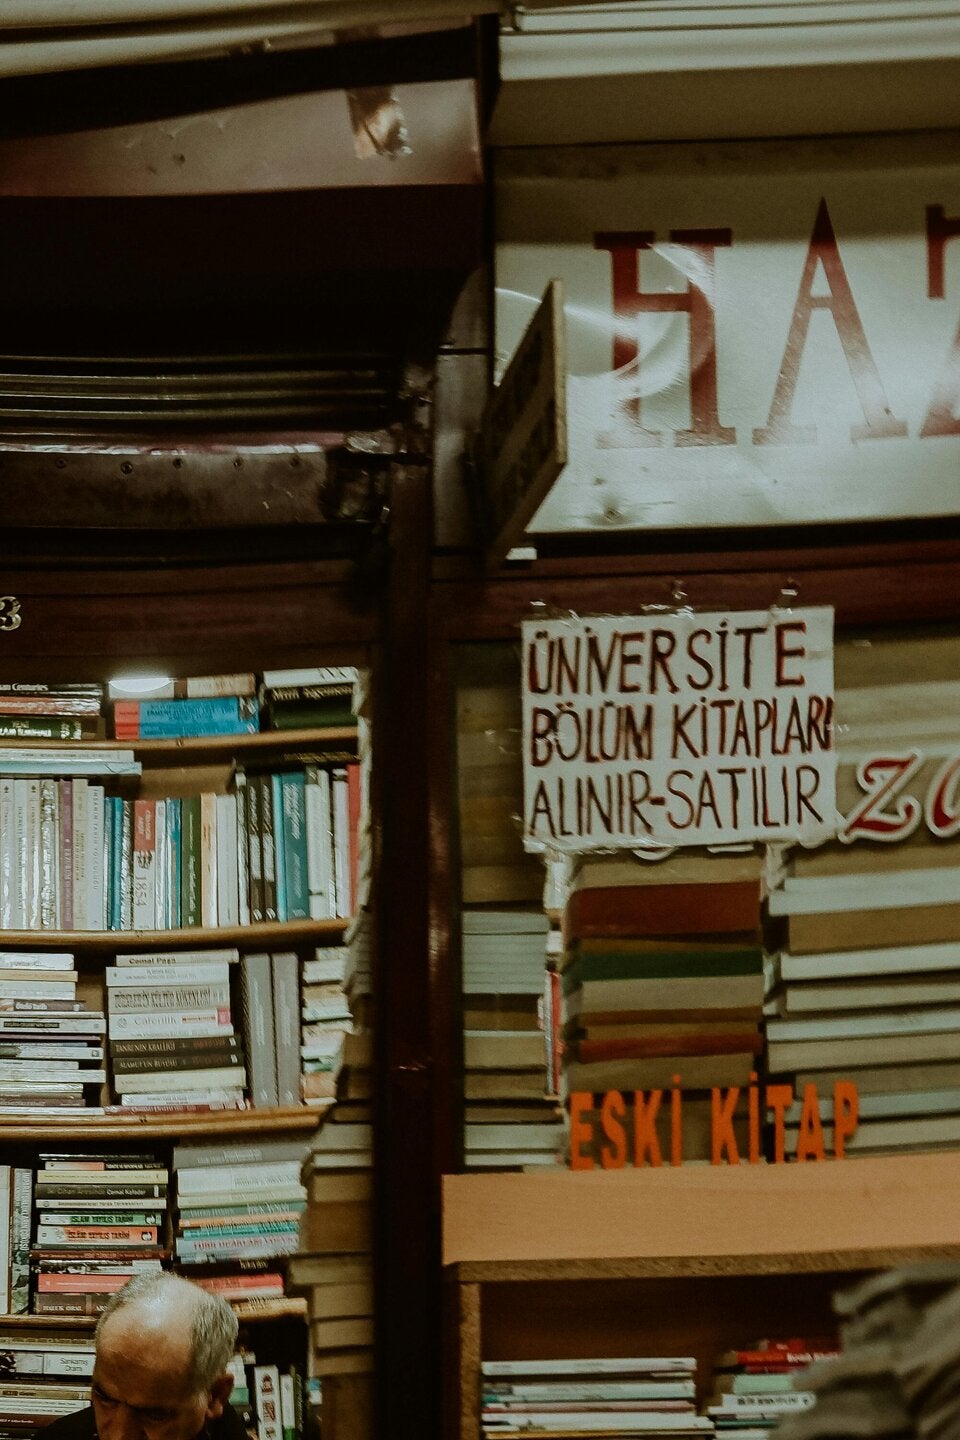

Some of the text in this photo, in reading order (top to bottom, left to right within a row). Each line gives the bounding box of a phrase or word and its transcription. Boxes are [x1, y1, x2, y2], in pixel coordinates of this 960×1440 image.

[594, 197, 960, 450] HA
[531, 695, 834, 767] BÖLÜM KİTAPLARI
[528, 765, 824, 837] ALINIR-SATILIR
[568, 1071, 860, 1171] ESKİ KİTAP
